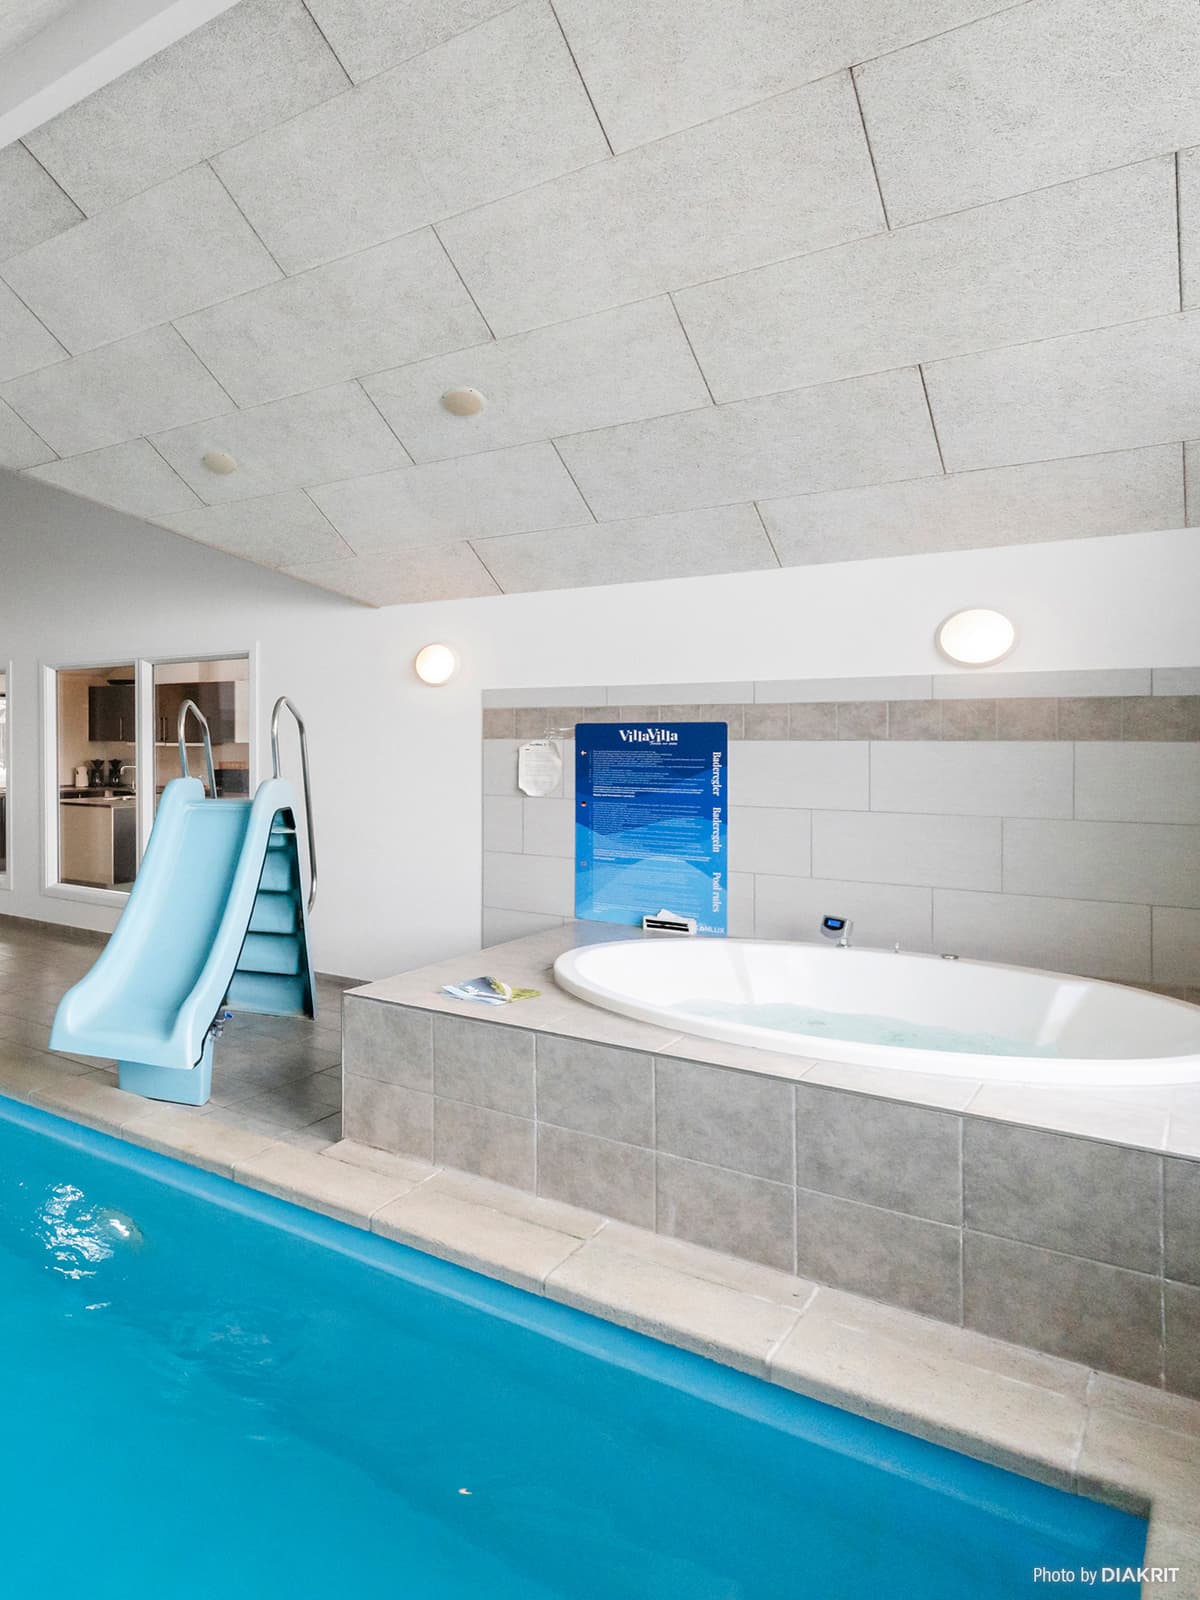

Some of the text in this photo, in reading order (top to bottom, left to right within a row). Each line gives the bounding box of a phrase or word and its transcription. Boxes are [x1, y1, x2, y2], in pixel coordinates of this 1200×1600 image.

[618, 728, 678, 743] VillaVilla
[712, 751, 722, 797] Baderegler
[712, 807, 721, 853] Baderegeln
[712, 872, 721, 912] Pool rules
